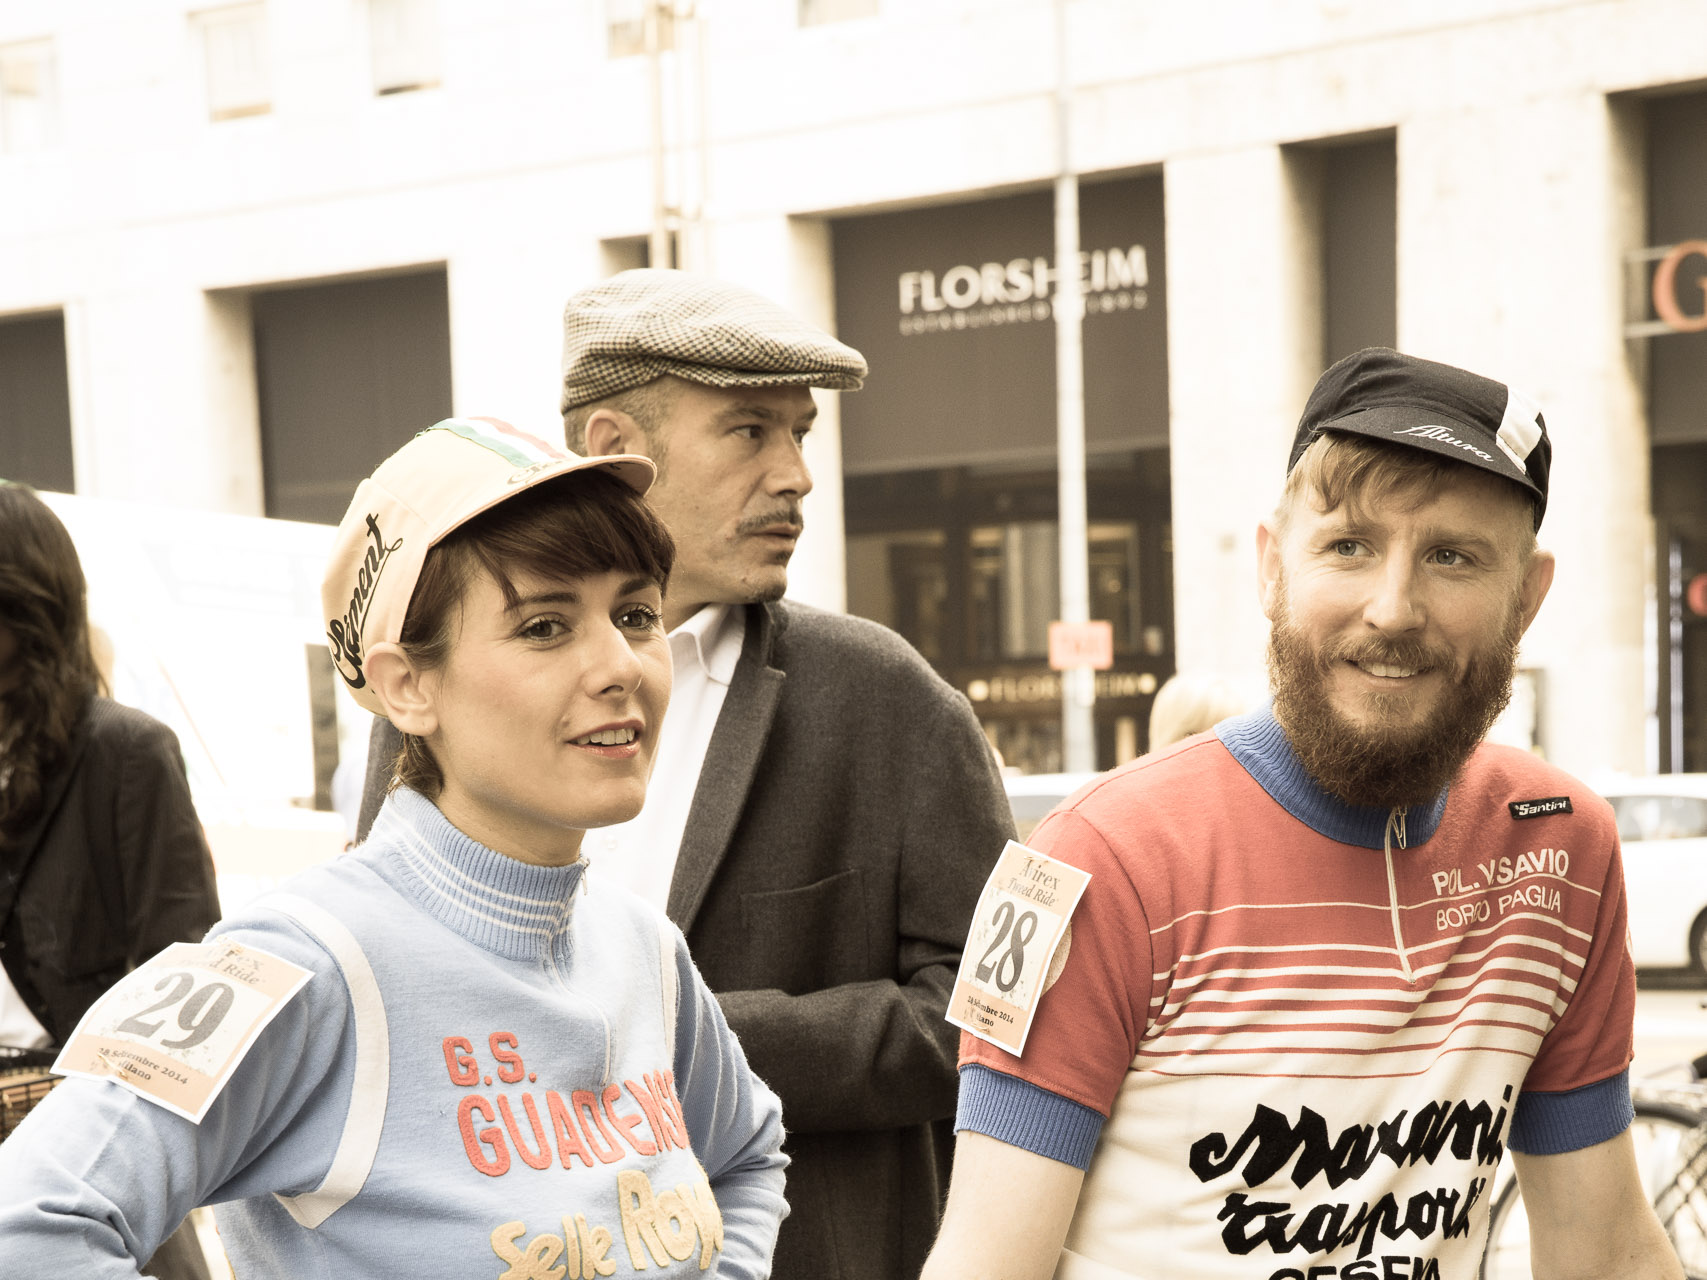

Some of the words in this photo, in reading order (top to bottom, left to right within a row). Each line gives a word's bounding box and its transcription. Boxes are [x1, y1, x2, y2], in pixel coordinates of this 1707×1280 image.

[899, 244, 1148, 314] FLORSHEIM
[1393, 425, 1494, 463] Altura
[1517, 800, 1567, 816] Santini
[1032, 885, 1057, 907] Ride
[1498, 885, 1561, 915] PAGLIA
[975, 901, 1038, 993] 28
[221, 963, 260, 985] Ride
[116, 972, 235, 1050] 29
[998, 1010, 1014, 1025] 2014
[442, 1031, 537, 1087] G.S.
[160, 1066, 188, 1085] 2014
